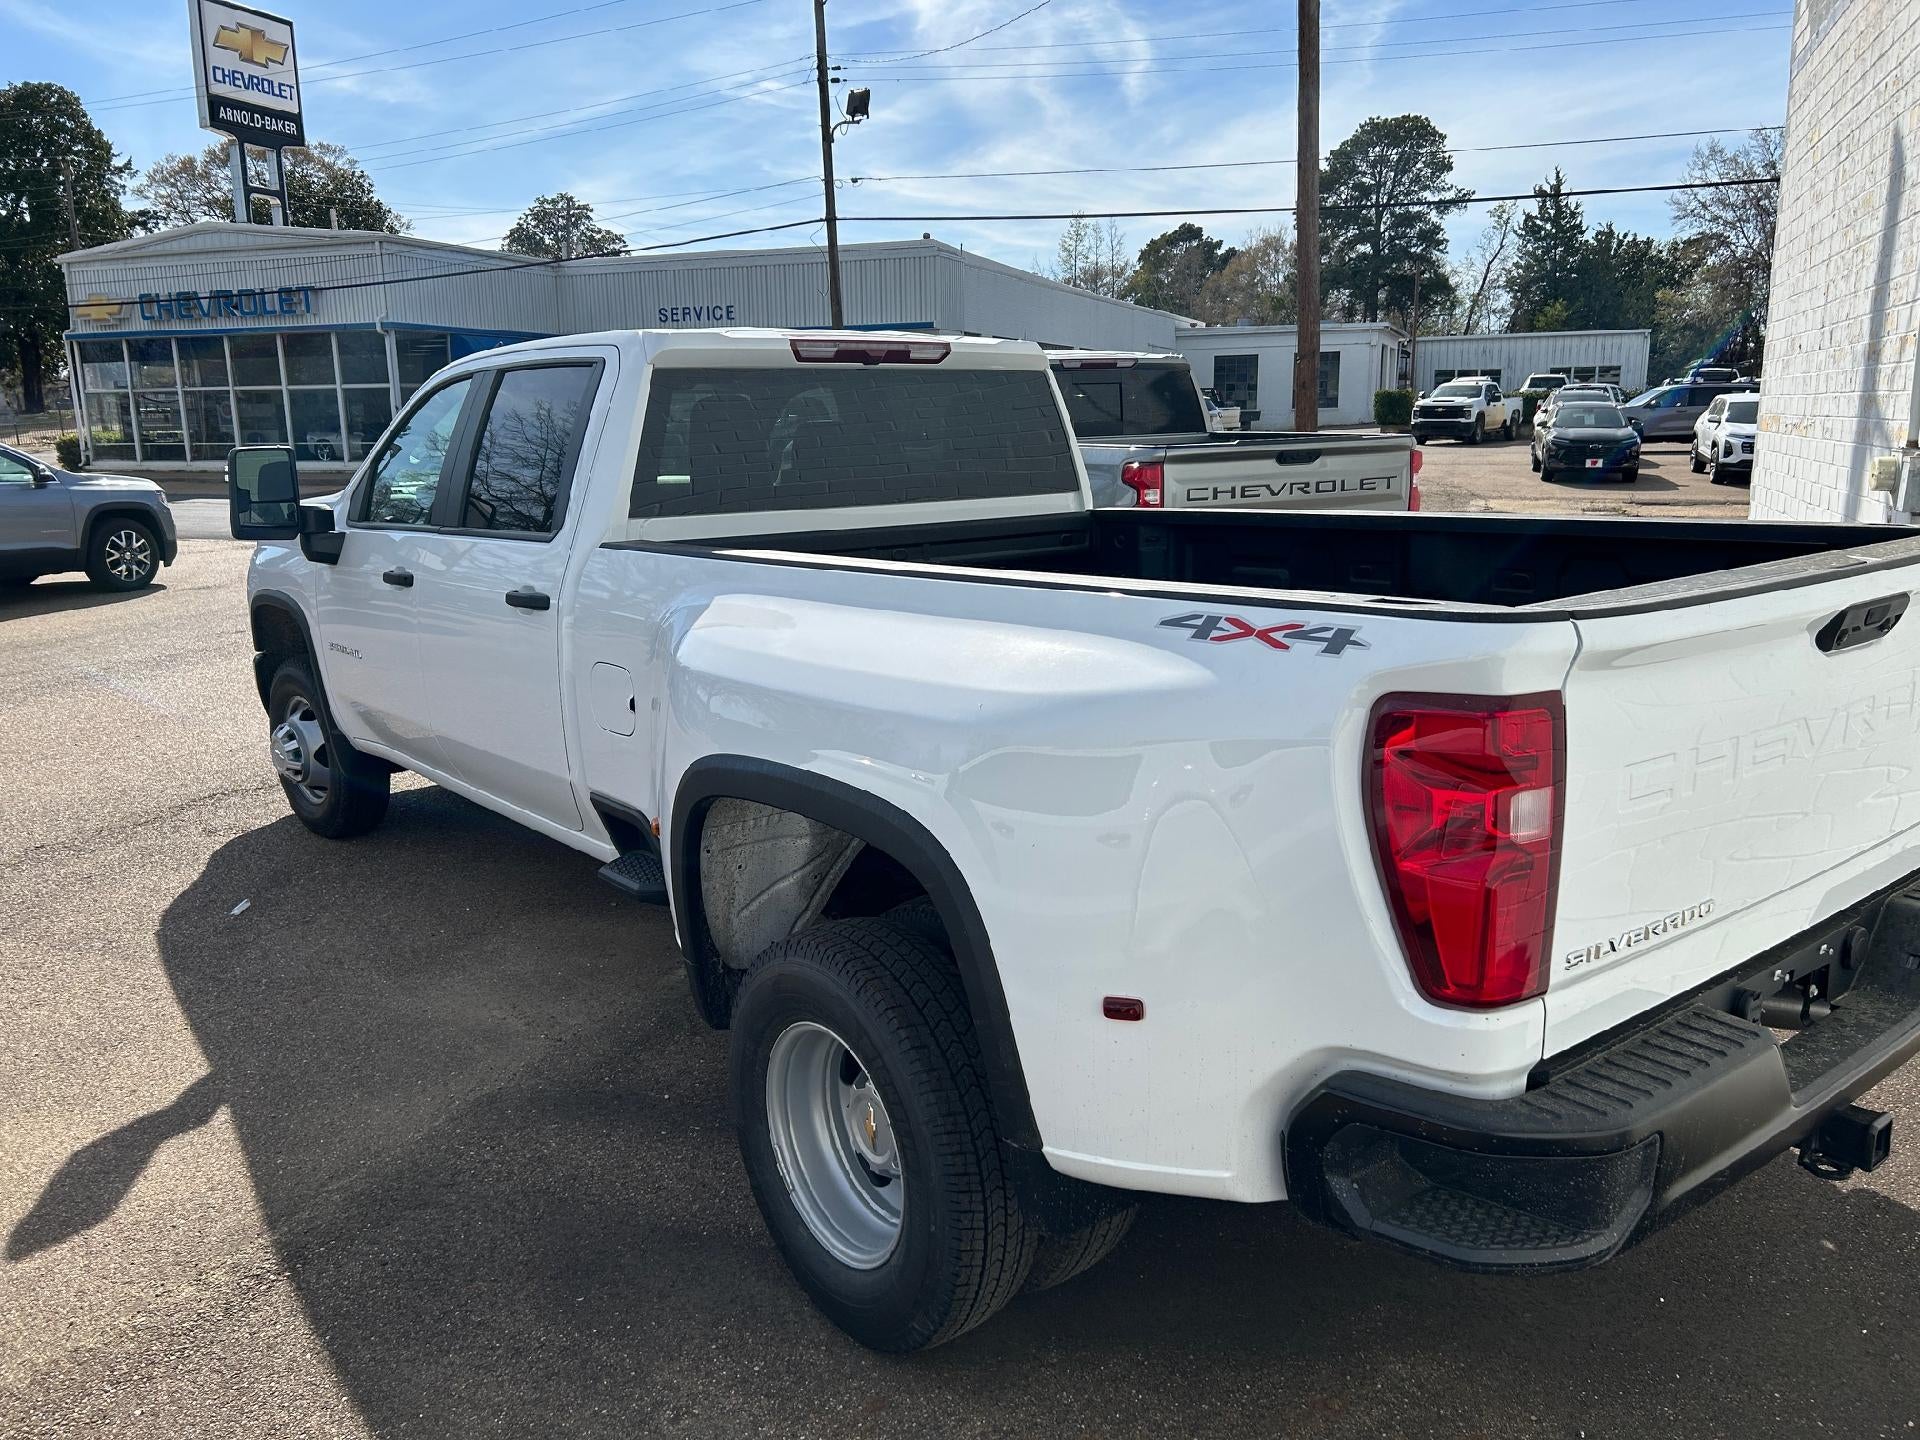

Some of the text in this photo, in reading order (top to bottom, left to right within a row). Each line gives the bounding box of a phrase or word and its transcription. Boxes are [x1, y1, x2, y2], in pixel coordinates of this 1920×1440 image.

[211, 65, 295, 101] CHEVROLET
[219, 106, 297, 135] ARNOLD-BAKER
[138, 286, 315, 321] CHEVROLET
[658, 305, 735, 323] SERVICE
[1186, 475, 1398, 502] CHEVROLET
[1565, 899, 1714, 971] SILVERADO
